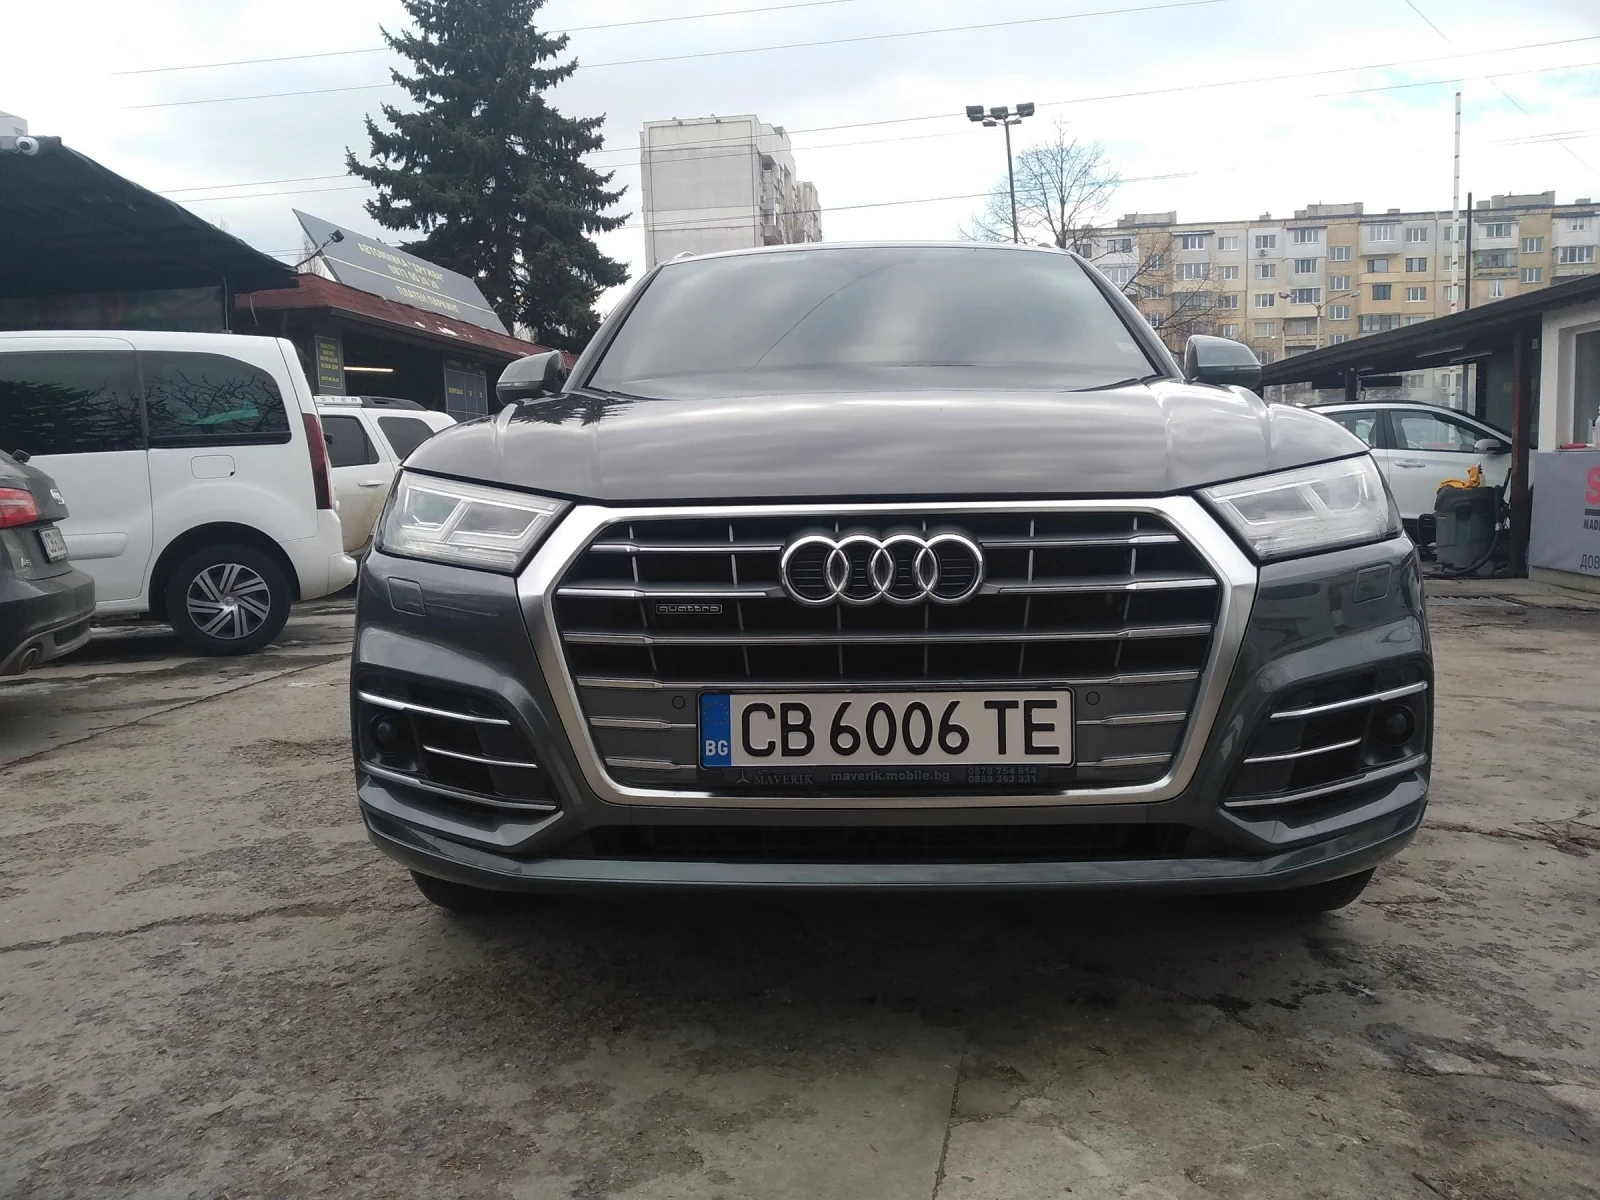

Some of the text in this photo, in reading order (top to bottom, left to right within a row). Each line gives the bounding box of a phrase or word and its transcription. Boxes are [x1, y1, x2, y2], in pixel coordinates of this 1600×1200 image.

[1583, 518, 1600, 530] MAD
[658, 605, 720, 613] quattro
[705, 700, 1060, 757] BG CB 6006 TE
[967, 766, 1037, 774] 0878 754 914
[753, 774, 815, 785] MAVERIK
[830, 770, 950, 782] maverik.mobile.bg
[967, 774, 993, 782] 0889
[1017, 774, 1037, 782] 331
